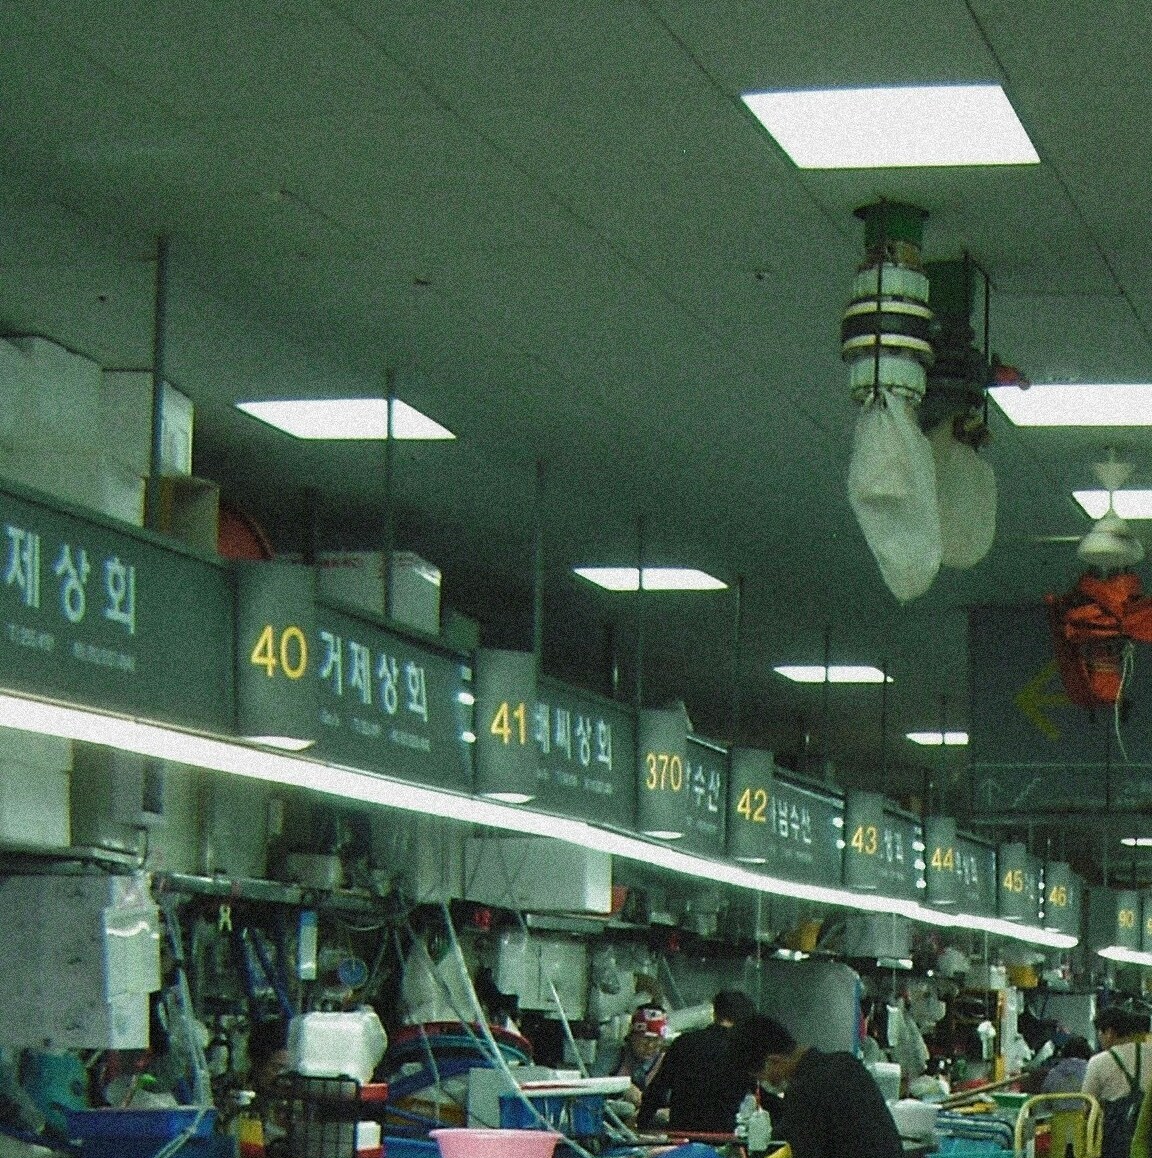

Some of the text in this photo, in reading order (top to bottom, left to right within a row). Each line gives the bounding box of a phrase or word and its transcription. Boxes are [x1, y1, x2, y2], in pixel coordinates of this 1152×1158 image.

[250, 624, 309, 680] 40
[319, 630, 428, 722] 거제상회
[490, 701, 527, 746] 41
[646, 752, 683, 792] 370
[736, 787, 768, 823] 42
[850, 825, 877, 855] 43
[931, 847, 954, 872] 44
[1003, 869, 1024, 893] 45
[1048, 885, 1067, 907] 46
